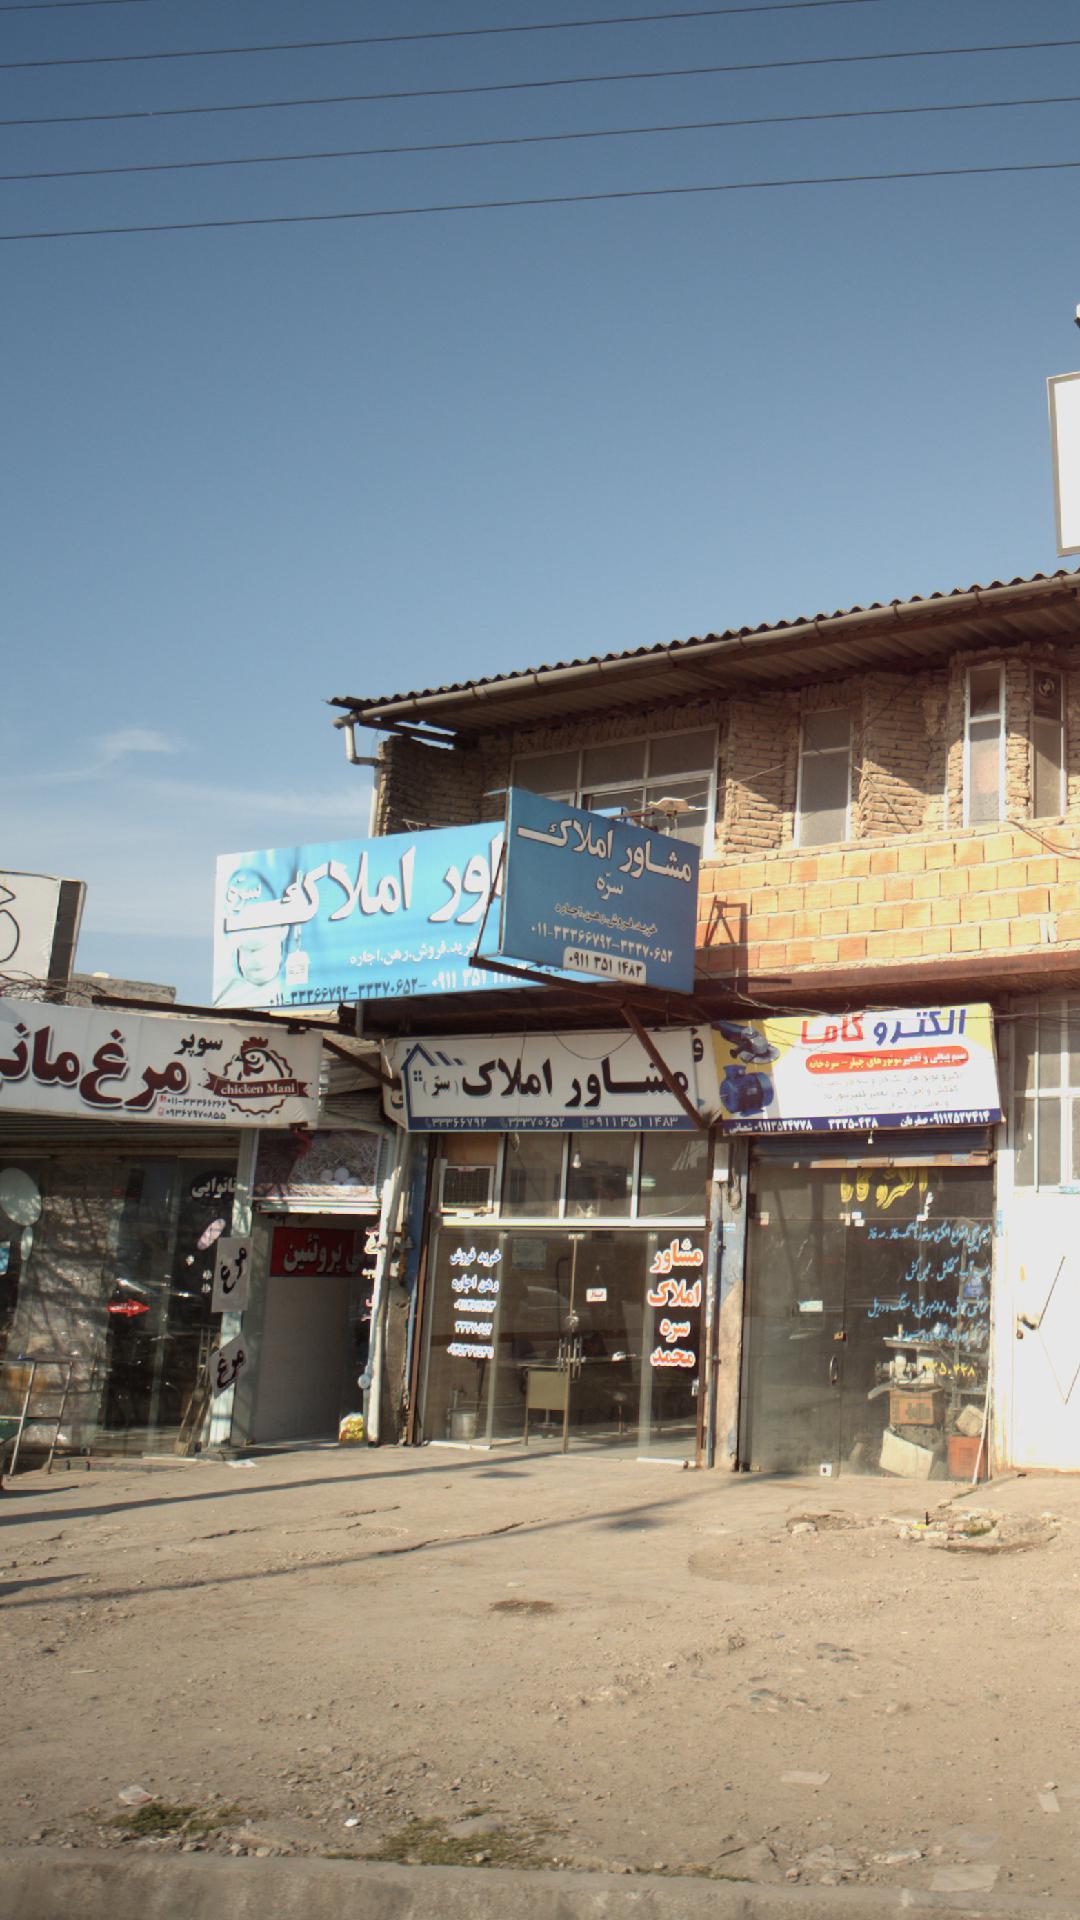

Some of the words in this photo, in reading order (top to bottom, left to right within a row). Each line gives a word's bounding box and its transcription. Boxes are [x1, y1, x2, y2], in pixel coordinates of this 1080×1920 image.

[517, 819, 613, 859] املاک
[619, 840, 692, 883] مشاور
[223, 845, 416, 932] املاک
[174, 1033, 222, 1056] سوپر
[873, 1009, 967, 1046] الکترو
[0, 1023, 80, 1080] مان
[79, 1029, 190, 1110] مرغ
[220, 1082, 265, 1096] chicken
[267, 1081, 296, 1094] Mani
[462, 1058, 552, 1097] املاک
[220, 1247, 247, 1294] مرغ
[283, 1233, 344, 1273] پروتئین
[449, 1246, 477, 1267] فروش
[478, 1248, 502, 1268] خرید
[650, 1238, 703, 1273] مشاور
[451, 1273, 478, 1295] اجاره
[648, 1279, 702, 1307] املاک
[659, 1318, 691, 1342] سره
[215, 1348, 246, 1390] مرغ
[650, 1346, 696, 1368] محمد
